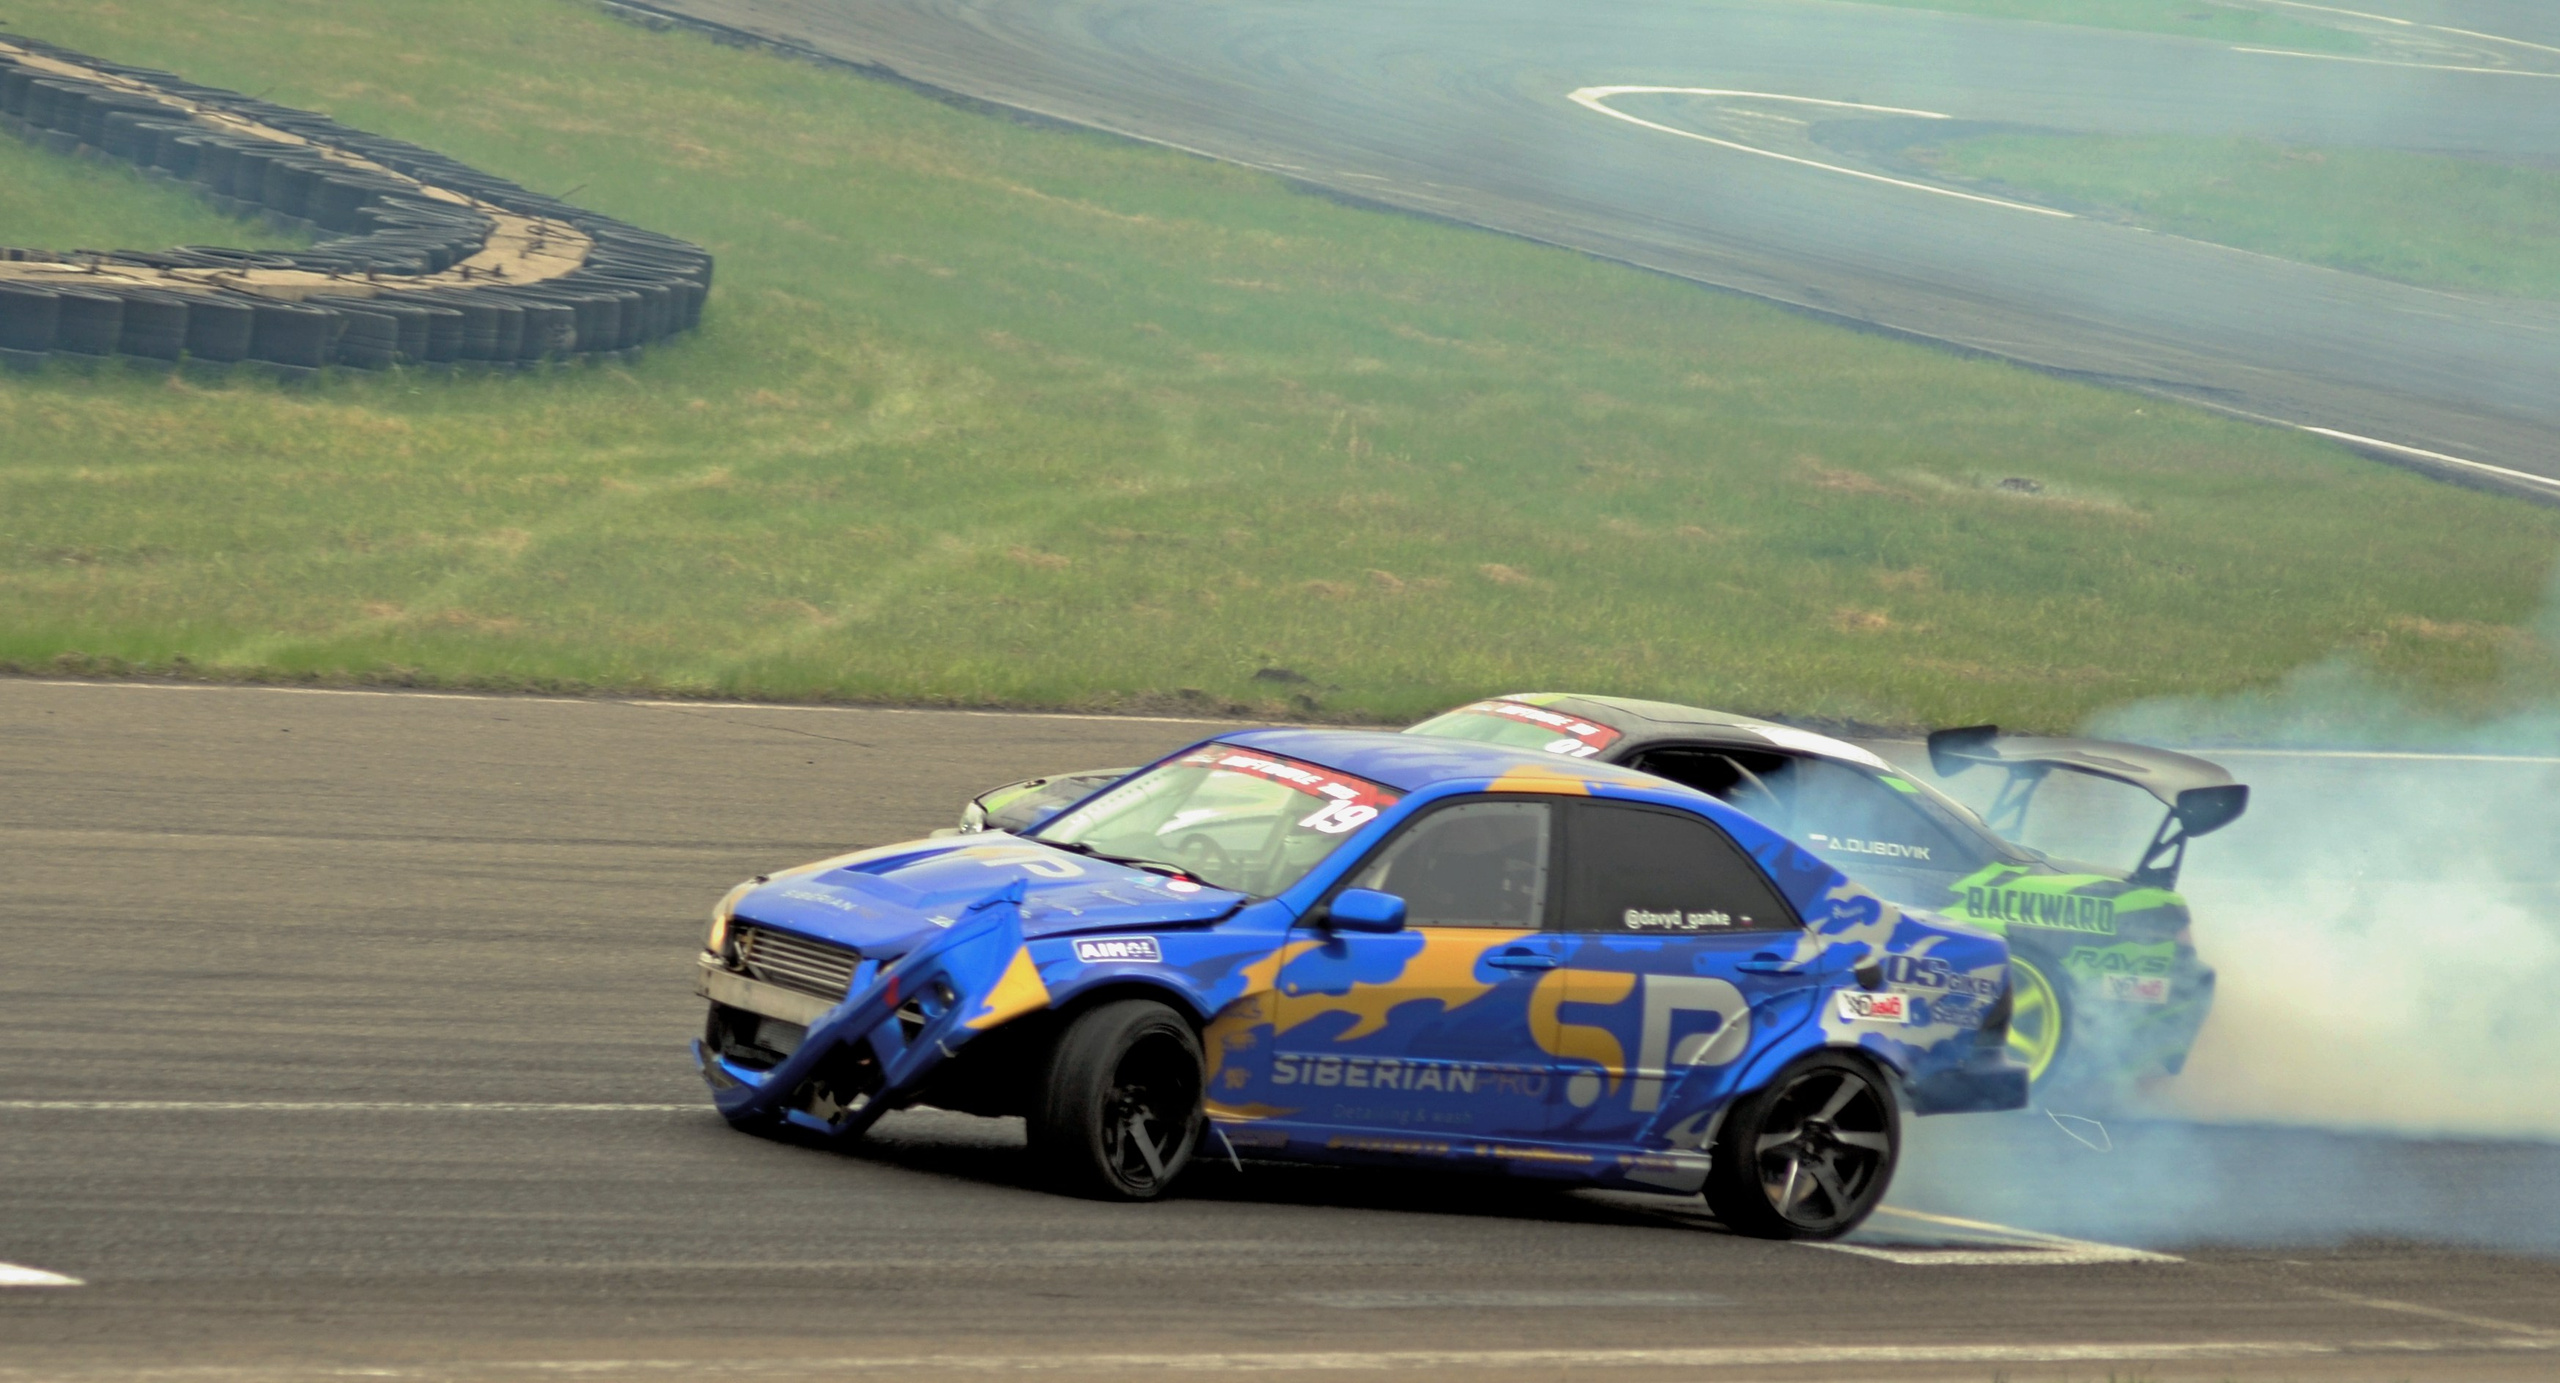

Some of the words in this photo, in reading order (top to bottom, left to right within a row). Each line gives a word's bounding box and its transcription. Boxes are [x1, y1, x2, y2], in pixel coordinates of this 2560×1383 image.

[1298, 799, 1378, 833] 19
[1828, 837, 1931, 860] A.DUBOVIK
[1967, 886, 2116, 934] BACKWARD
[2069, 949, 2169, 973] RAYS
